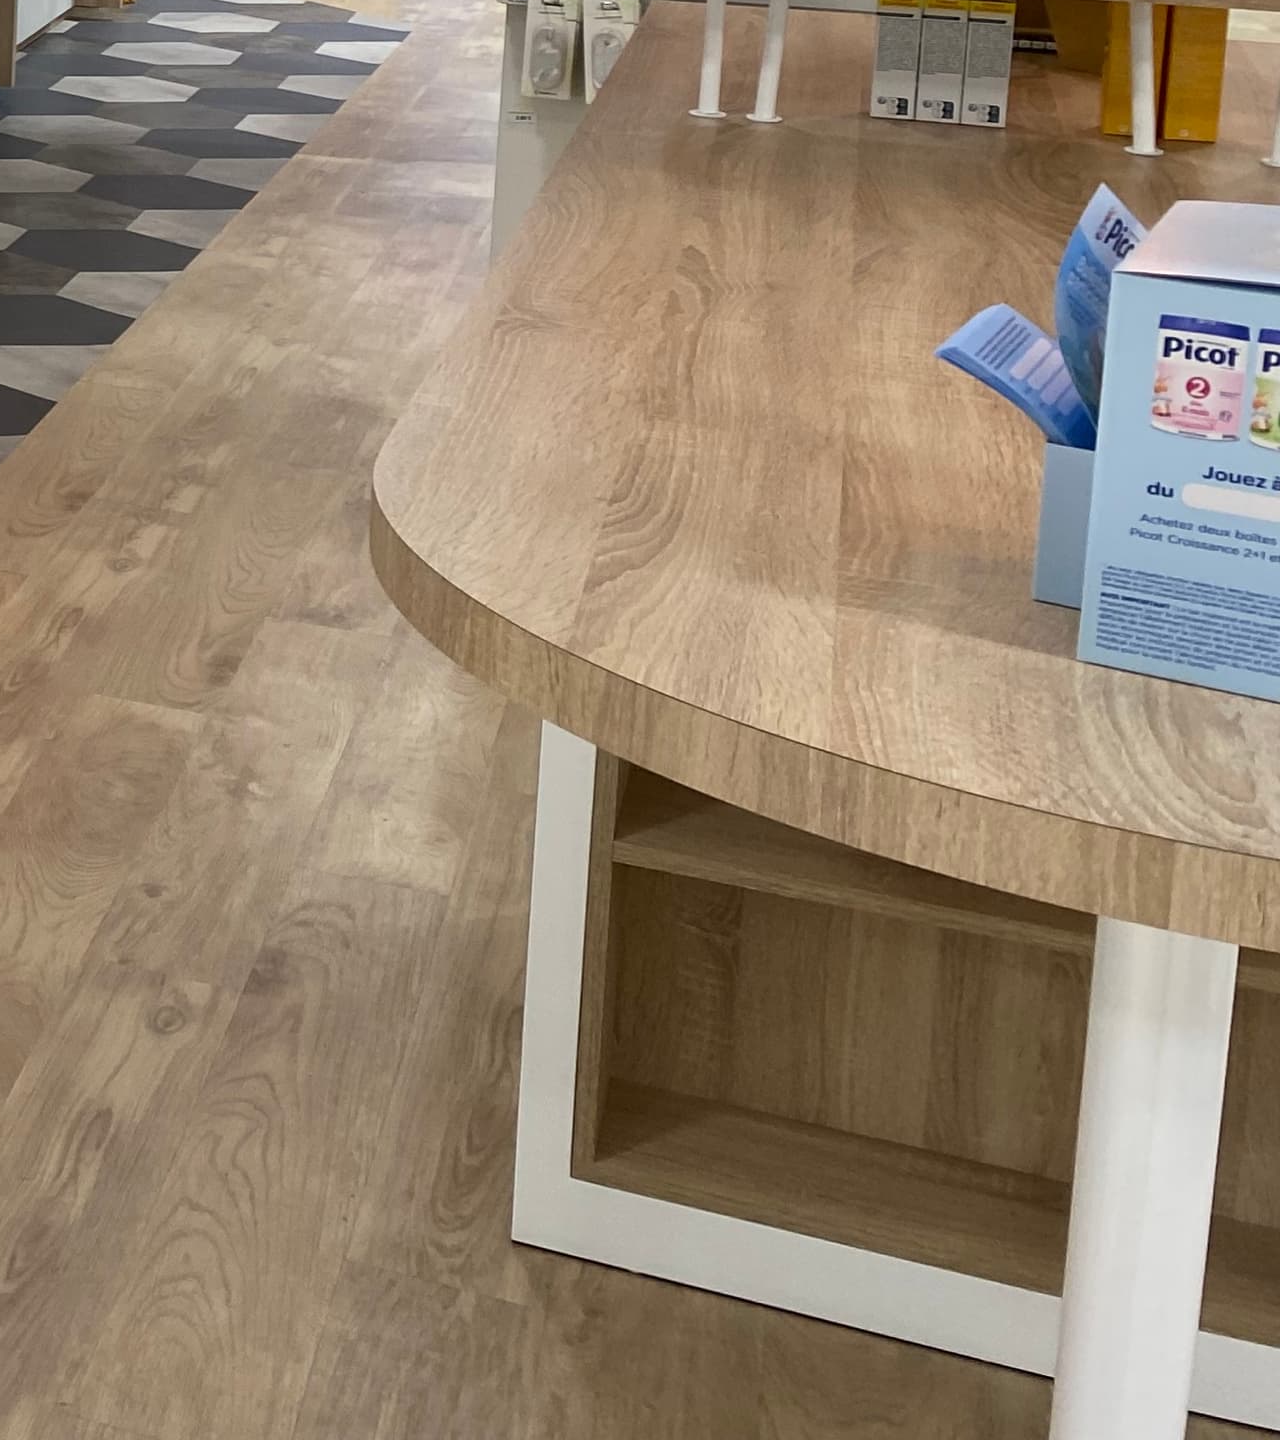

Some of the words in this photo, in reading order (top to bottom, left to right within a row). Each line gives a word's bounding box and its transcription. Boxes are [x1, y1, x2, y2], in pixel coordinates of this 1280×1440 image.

[1163, 336, 1240, 367] Picot
[1190, 379, 1206, 397] 2
[1146, 481, 1174, 498] du
[1202, 466, 1268, 489] Jouez
[1130, 527, 1163, 541] Picot
[1168, 534, 1240, 555] Croissance
[1140, 514, 1194, 531] Achetez
[1198, 524, 1231, 538] deux
[1234, 529, 1278, 546] boîtes
